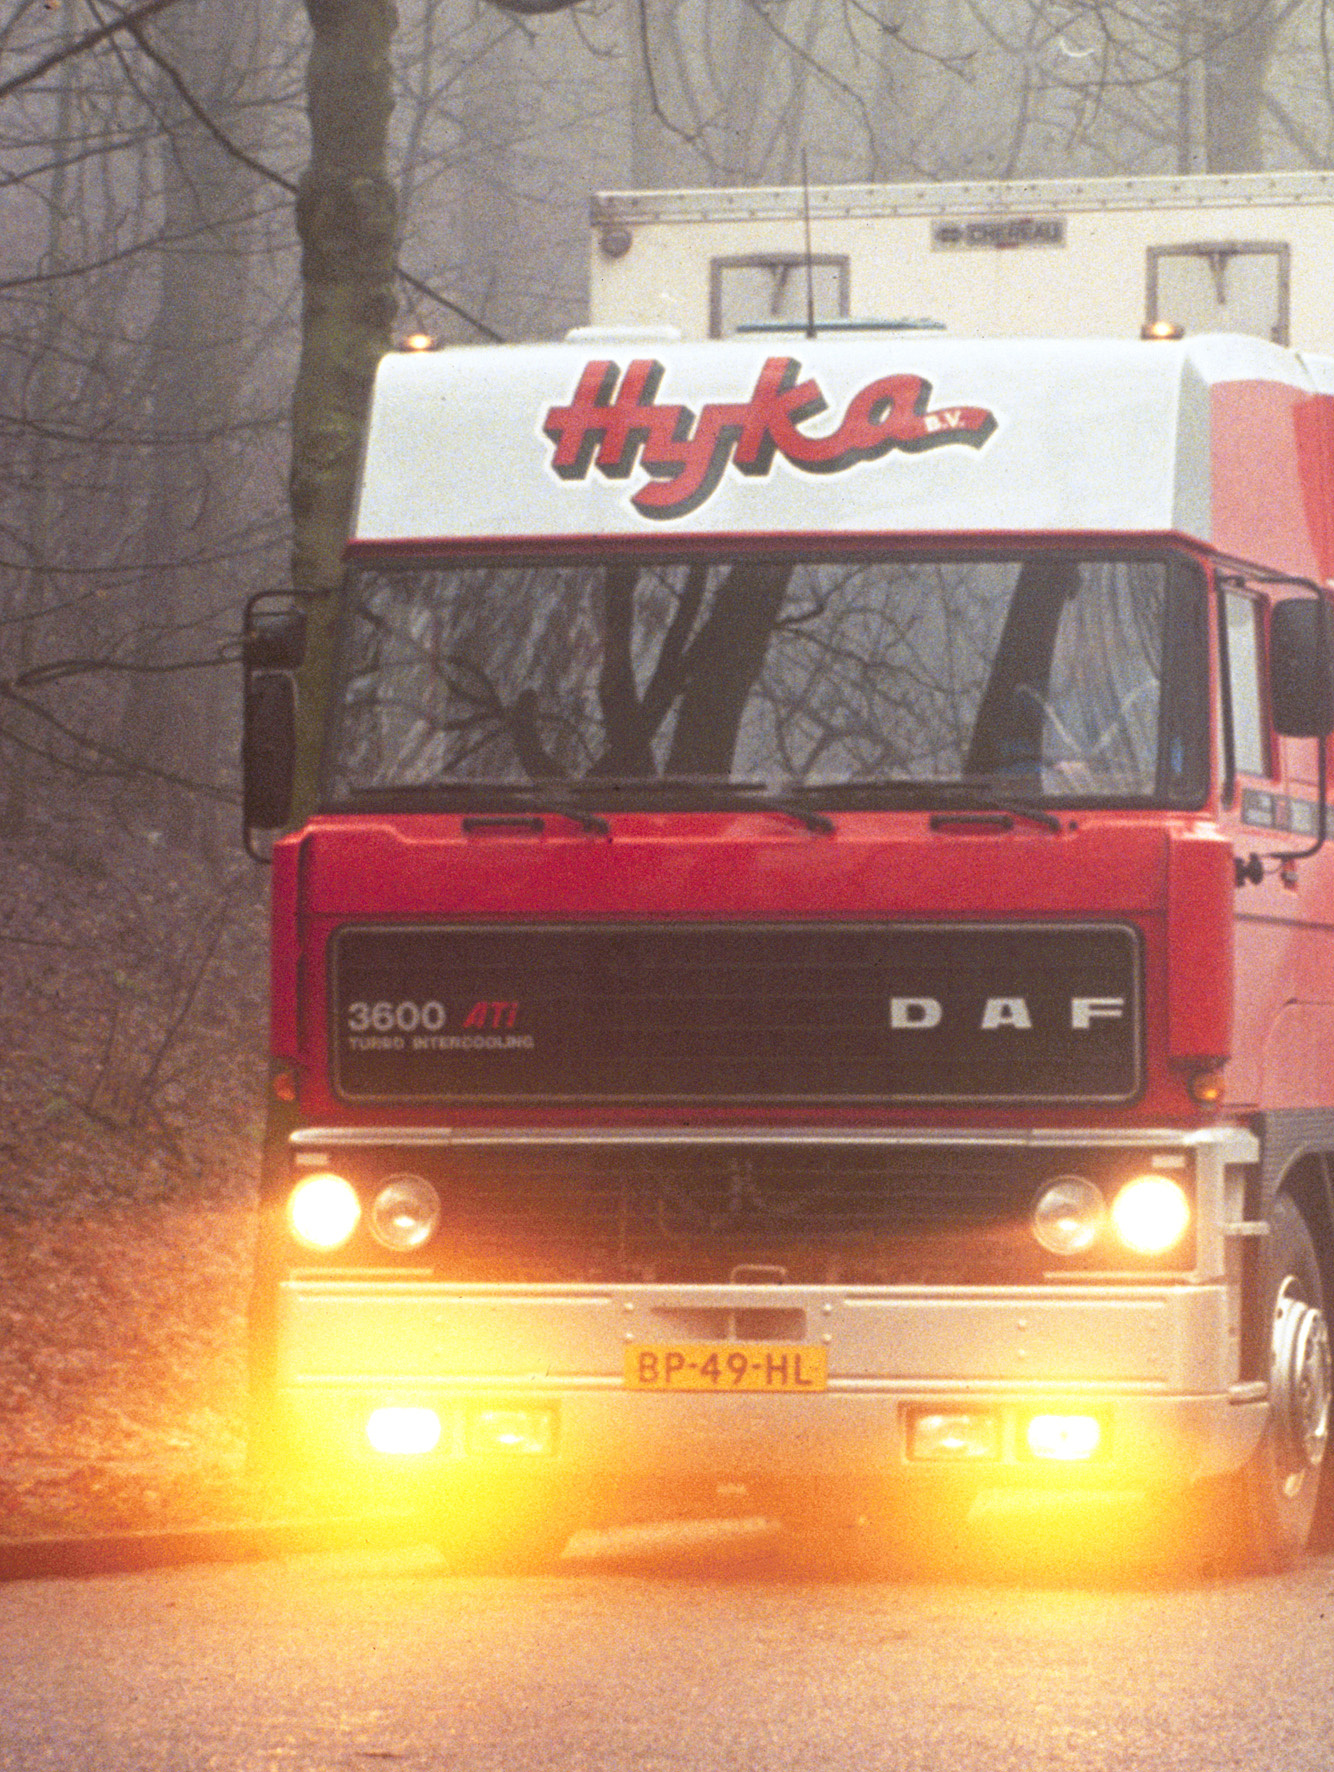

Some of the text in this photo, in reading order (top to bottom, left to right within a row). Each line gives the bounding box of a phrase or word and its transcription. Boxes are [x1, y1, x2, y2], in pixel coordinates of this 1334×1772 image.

[543, 357, 998, 521] Hyka B.V.
[348, 1001, 447, 1031] 3600
[891, 997, 1126, 1029] DAF
[350, 1035, 535, 1050] TURBO INTERCOOLING
[638, 1351, 813, 1386] BP-49-HL
